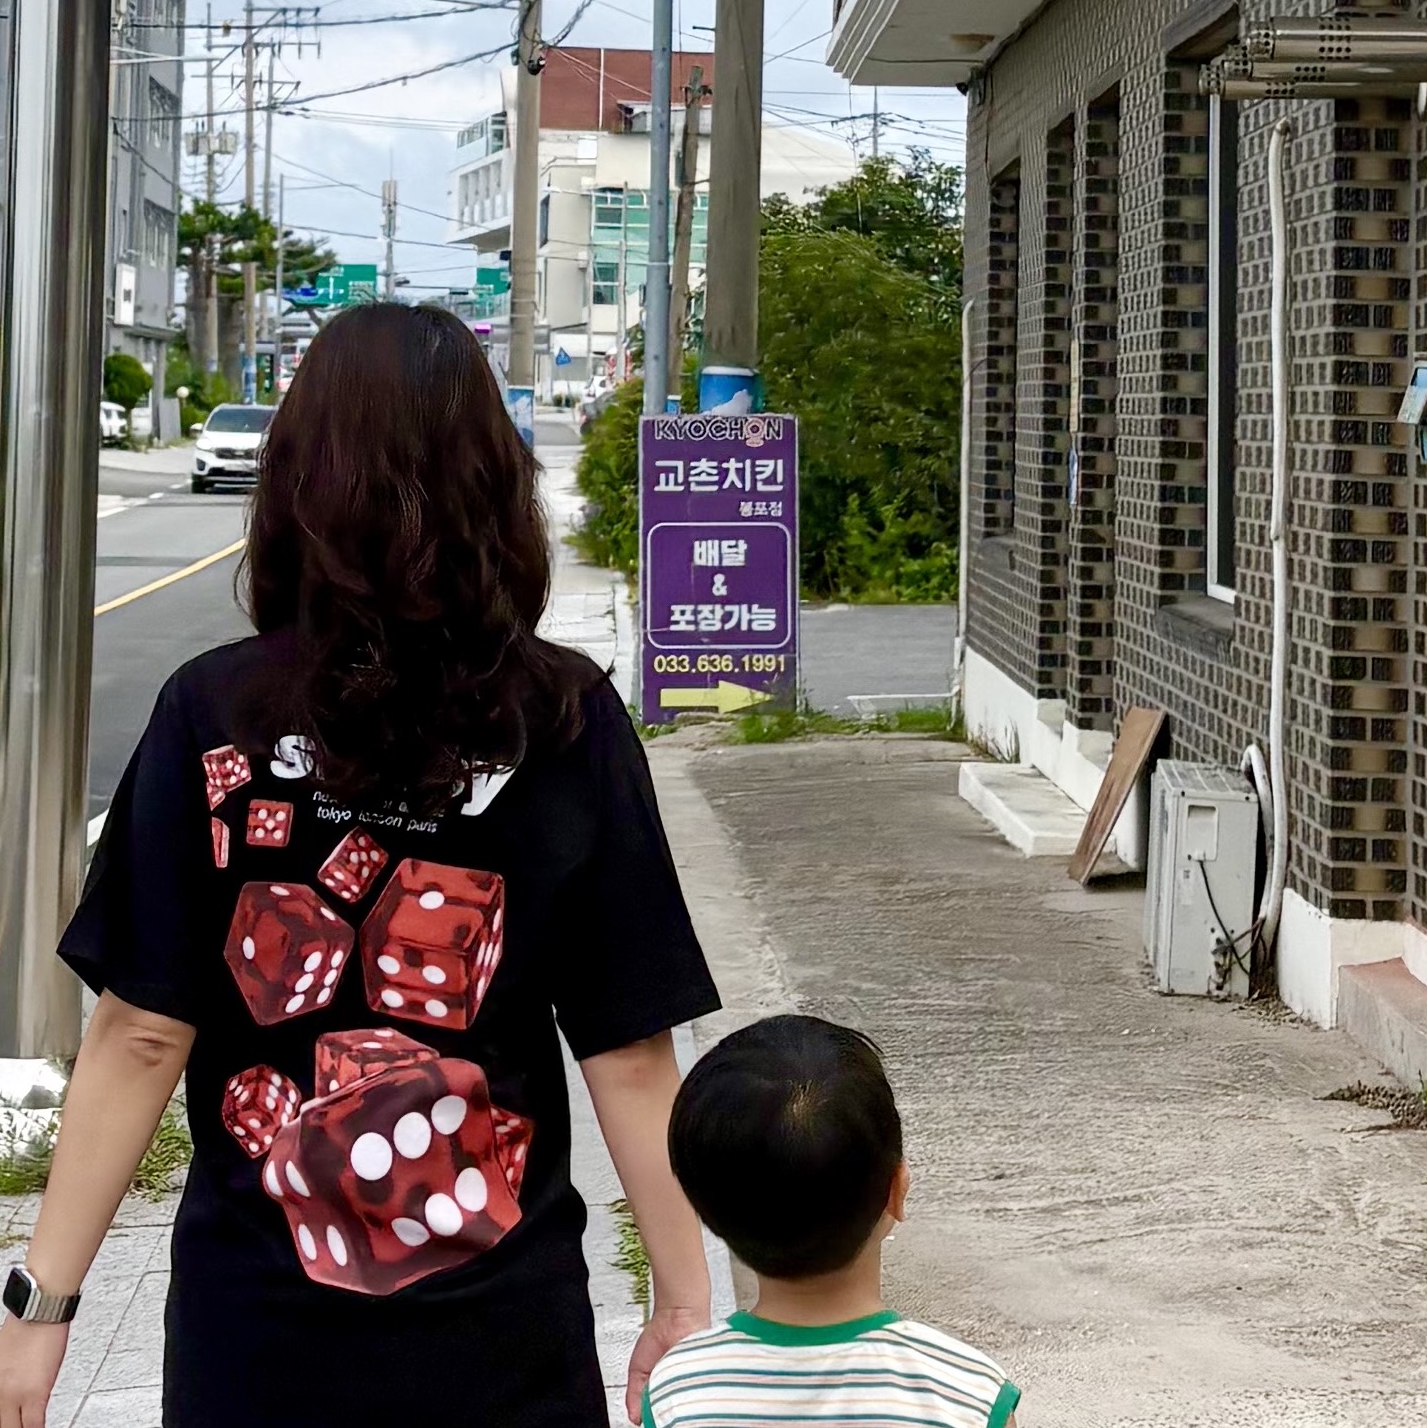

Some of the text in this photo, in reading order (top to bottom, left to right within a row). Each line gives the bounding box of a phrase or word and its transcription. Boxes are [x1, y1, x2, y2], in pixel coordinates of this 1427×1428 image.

[654, 417, 784, 441] KYOCHON
[653, 457, 785, 492] 교촌치킨
[692, 539, 748, 567] 배달
[711, 573, 728, 596] &
[668, 603, 777, 632] 포장가능
[653, 653, 786, 673] 033.636.1991
[316, 805, 353, 825] tokyo
